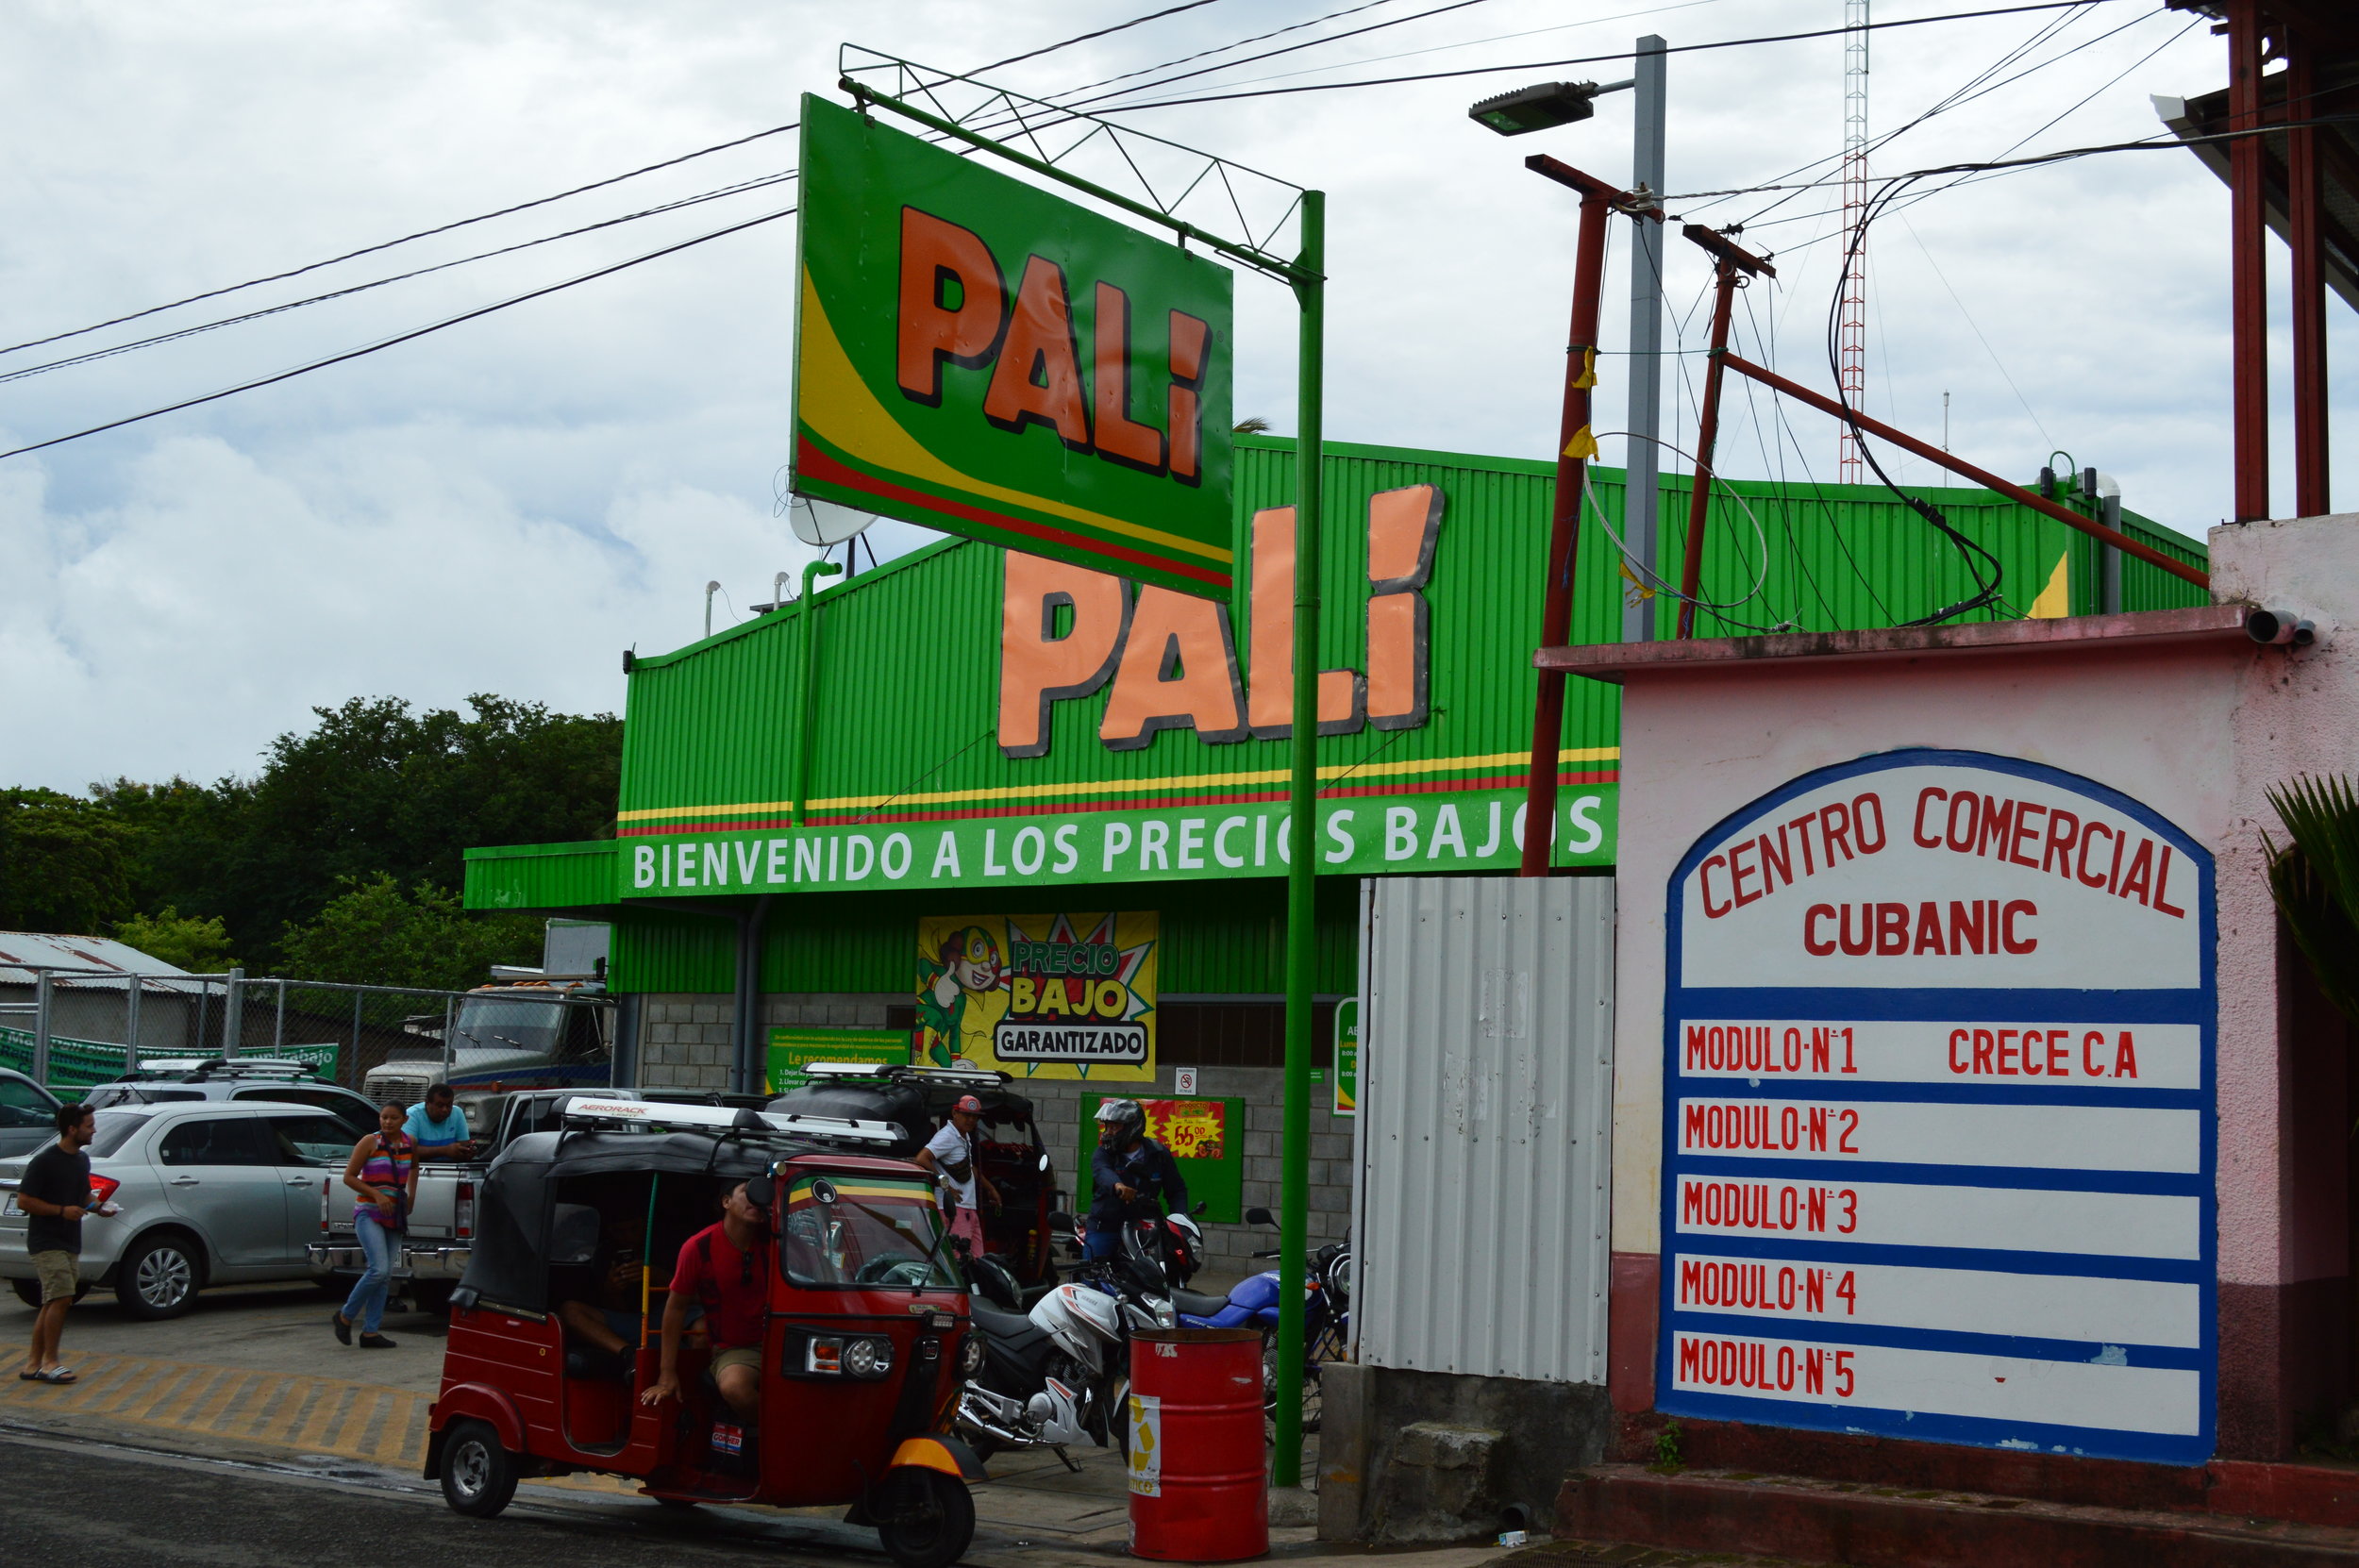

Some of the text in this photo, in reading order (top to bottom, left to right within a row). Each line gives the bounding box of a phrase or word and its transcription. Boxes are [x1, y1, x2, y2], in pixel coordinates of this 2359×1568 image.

[634, 831, 912, 889] BIENVENIDO
[931, 830, 961, 878] A
[983, 824, 1079, 876] LOS
[1698, 787, 2186, 920] CENTRO COMERCIAL
[1803, 899, 2038, 957] CUBANIC
[1012, 941, 1120, 976] PRECIO
[1012, 976, 1129, 1019] BAJO
[788, 1052, 801, 1065] Le
[1001, 1030, 1143, 1055] GARANTIZADO
[1948, 1028, 2069, 1076] CRECE
[577, 1103, 649, 1114] AERORACK
